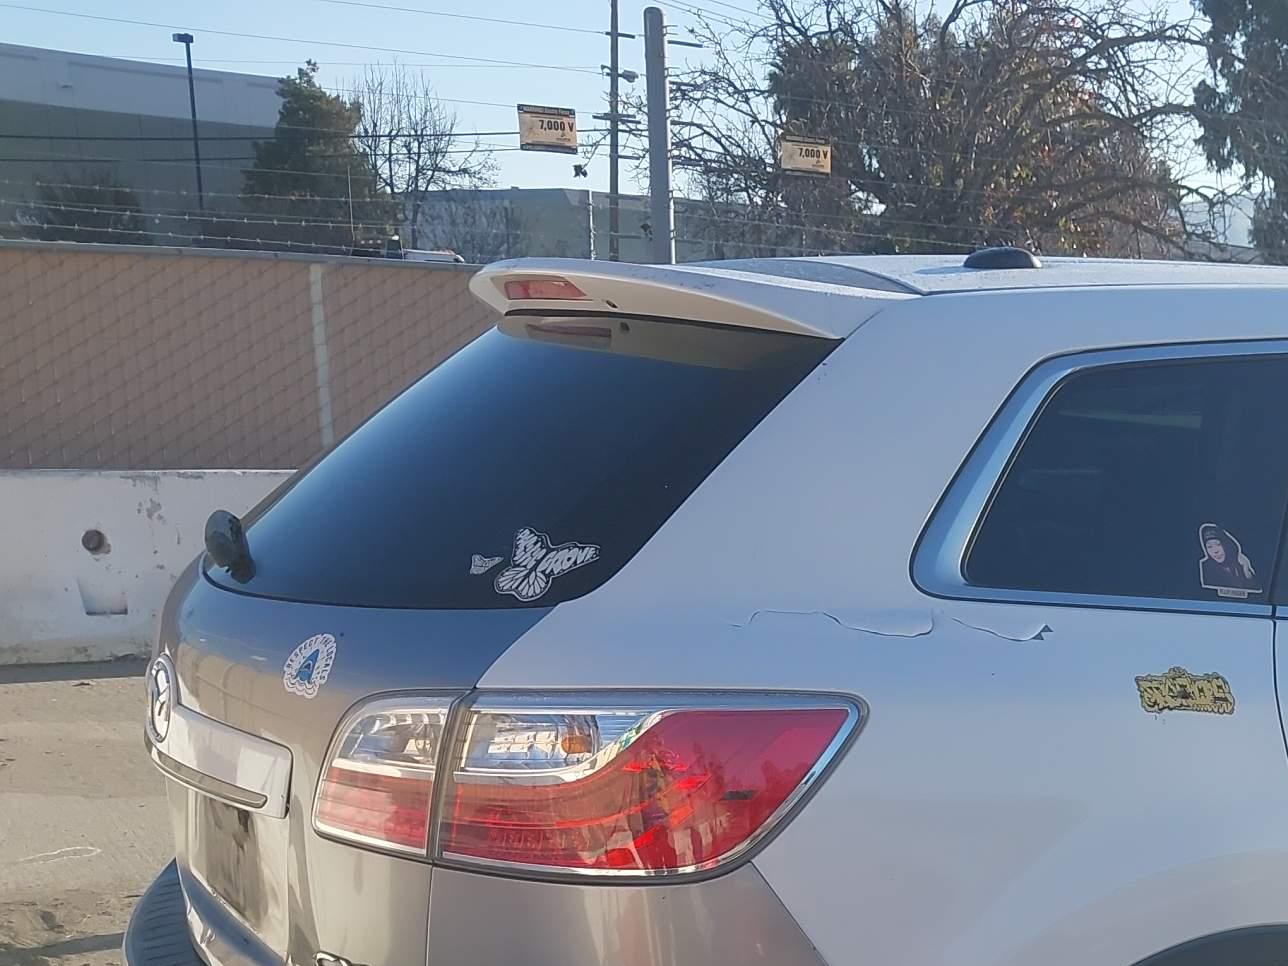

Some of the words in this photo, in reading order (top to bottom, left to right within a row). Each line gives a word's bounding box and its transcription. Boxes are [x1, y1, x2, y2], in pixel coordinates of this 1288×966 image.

[539, 119, 566, 132] 7,000
[568, 122, 575, 132] V
[799, 148, 821, 159] 7,000
[822, 150, 829, 160] V
[286, 637, 319, 670] RESPECT
[319, 645, 335, 681] LOCALS
